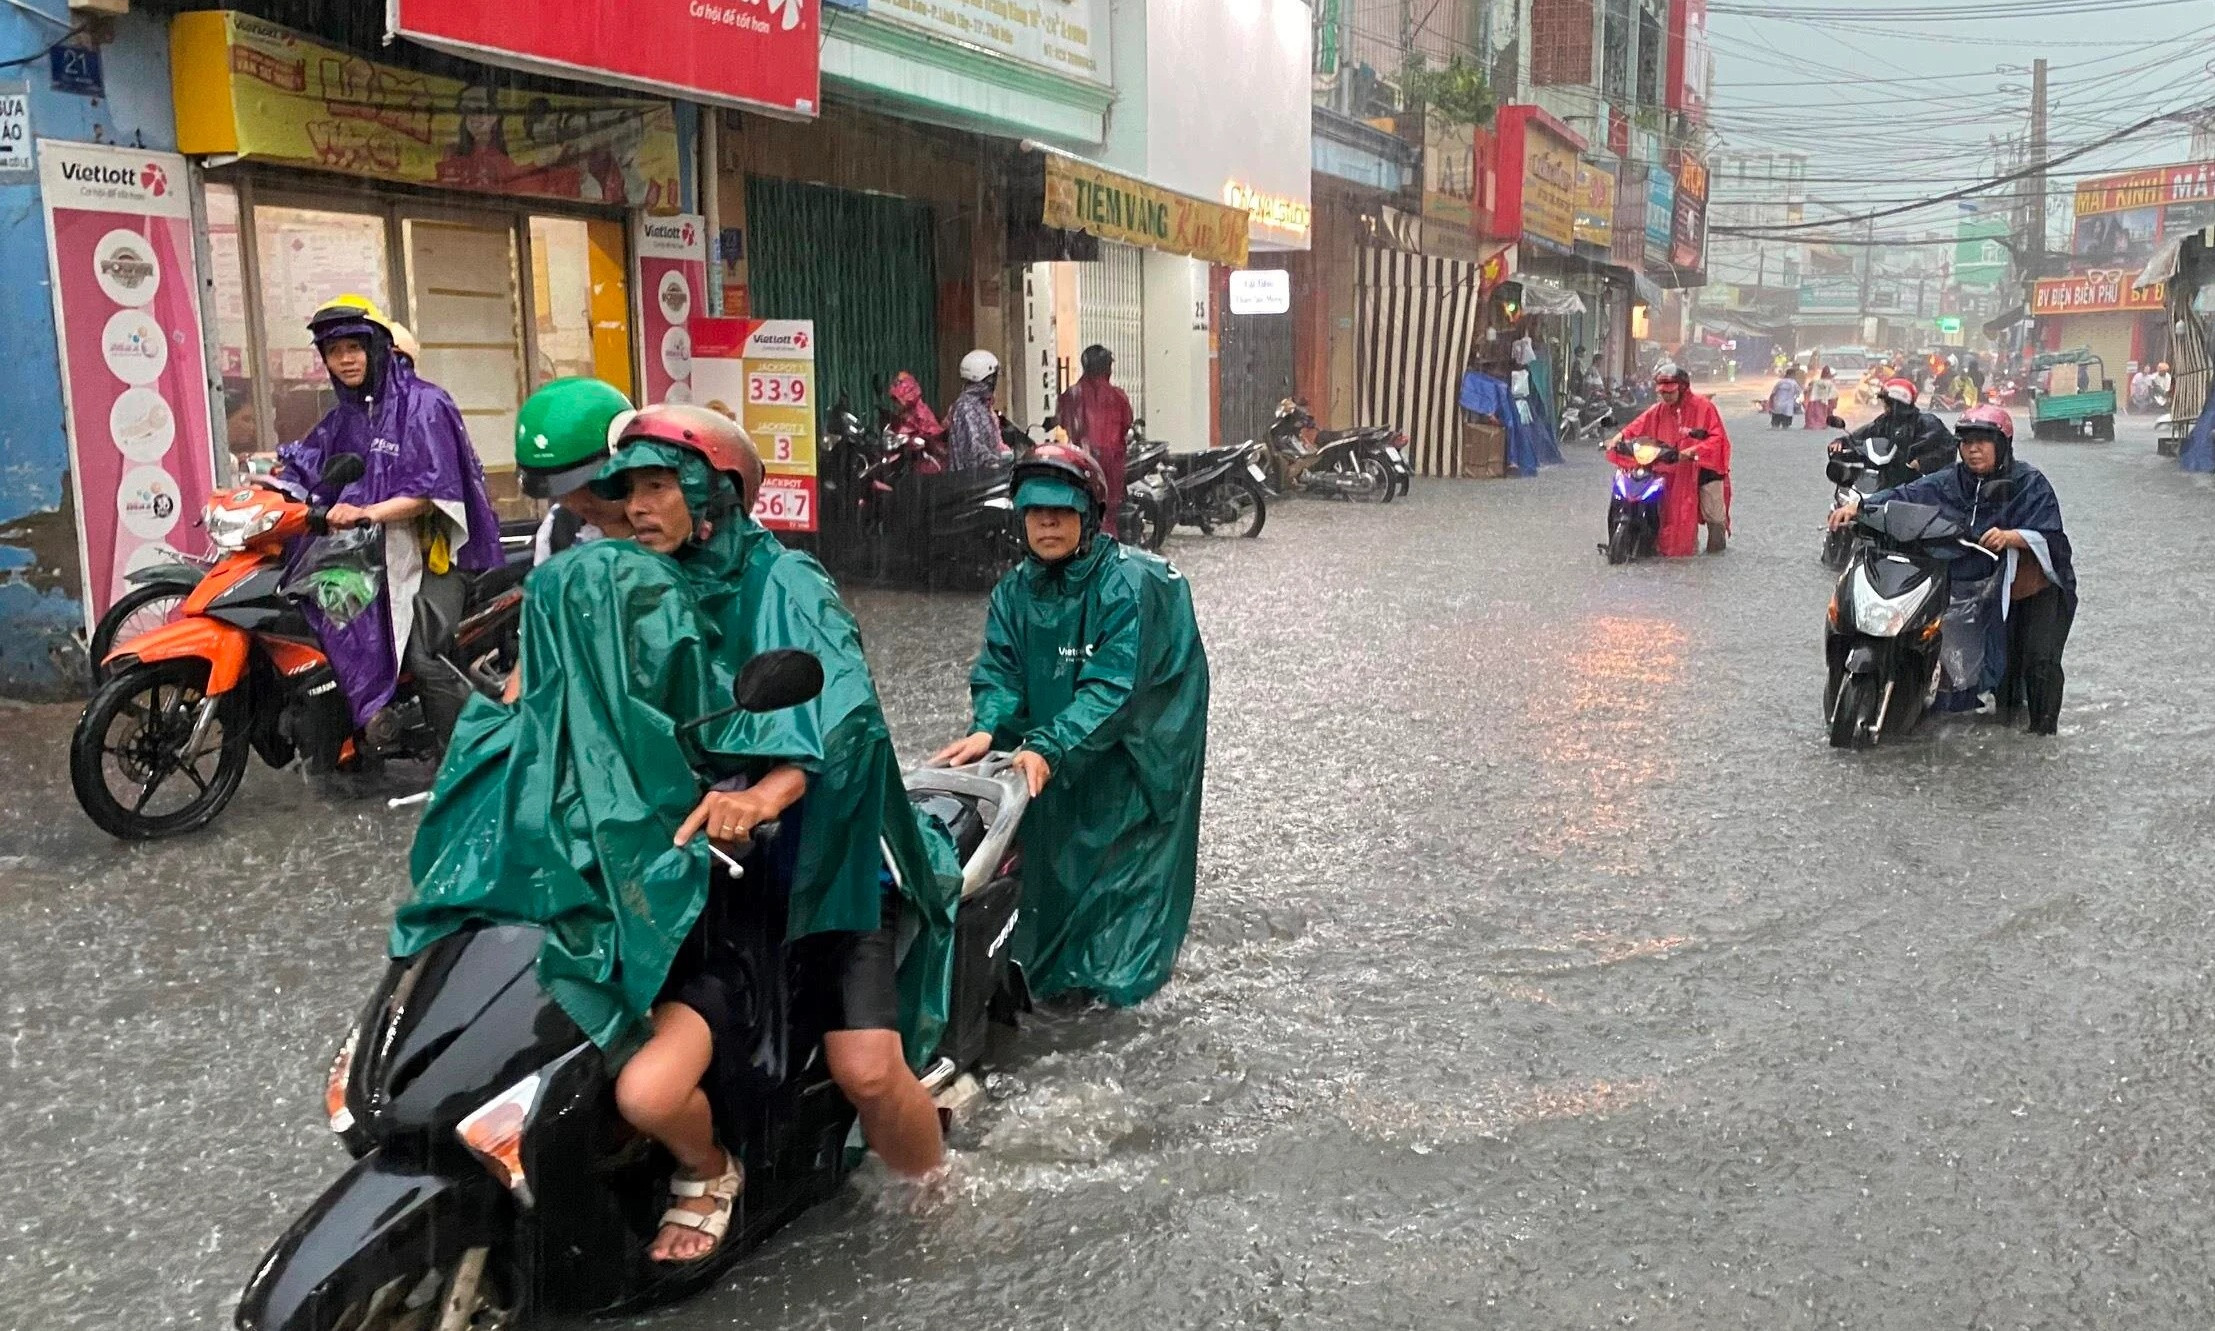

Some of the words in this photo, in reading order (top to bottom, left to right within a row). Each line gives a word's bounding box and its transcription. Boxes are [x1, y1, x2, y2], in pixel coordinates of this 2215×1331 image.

[689, 0, 704, 17] Cơ
[704, 3, 721, 25] hội
[63, 49, 88, 77] 21
[61, 161, 136, 186] Vietlott
[1074, 171, 1122, 232] TIỆM
[1123, 185, 1169, 240] VÀNG
[644, 224, 681, 240] Vietlott
[1195, 301, 1205, 318] 25
[753, 334, 792, 345] Vietlott
[750, 377, 805, 403] 33.9
[777, 438, 790, 460] 3
[763, 478, 802, 488] JACKPOT
[287, 659, 318, 675] 110
